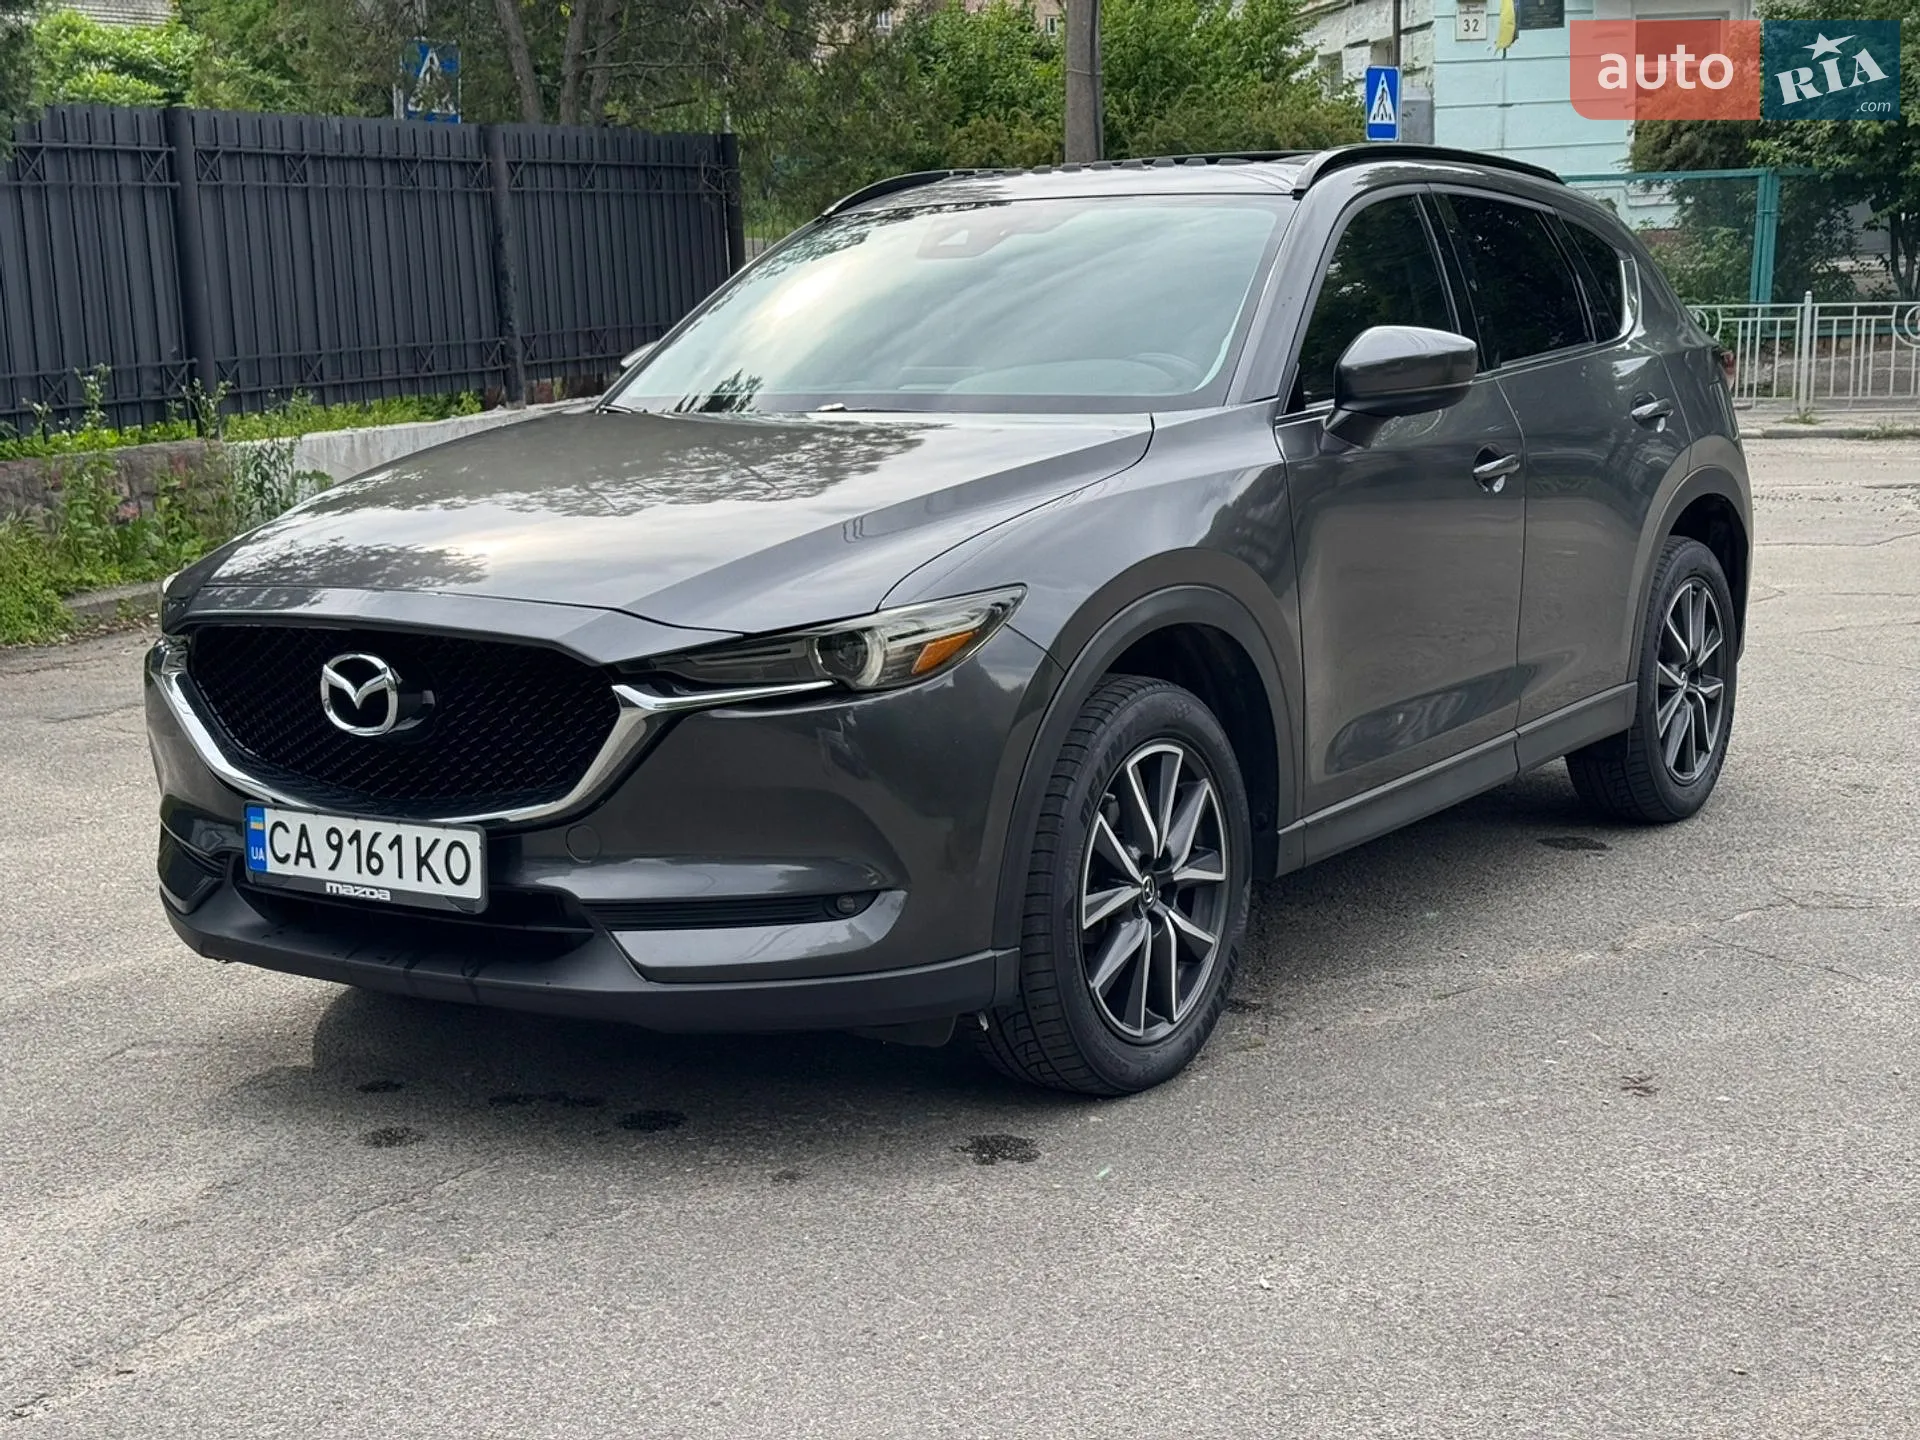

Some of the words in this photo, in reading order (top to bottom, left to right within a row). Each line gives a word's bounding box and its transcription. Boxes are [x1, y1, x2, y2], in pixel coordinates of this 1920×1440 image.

[1463, 18, 1480, 33] 32
[251, 846, 265, 862] UA
[269, 820, 316, 869] CA
[325, 826, 403, 879] 9161
[416, 835, 472, 886] KO
[326, 881, 391, 901] mazda
